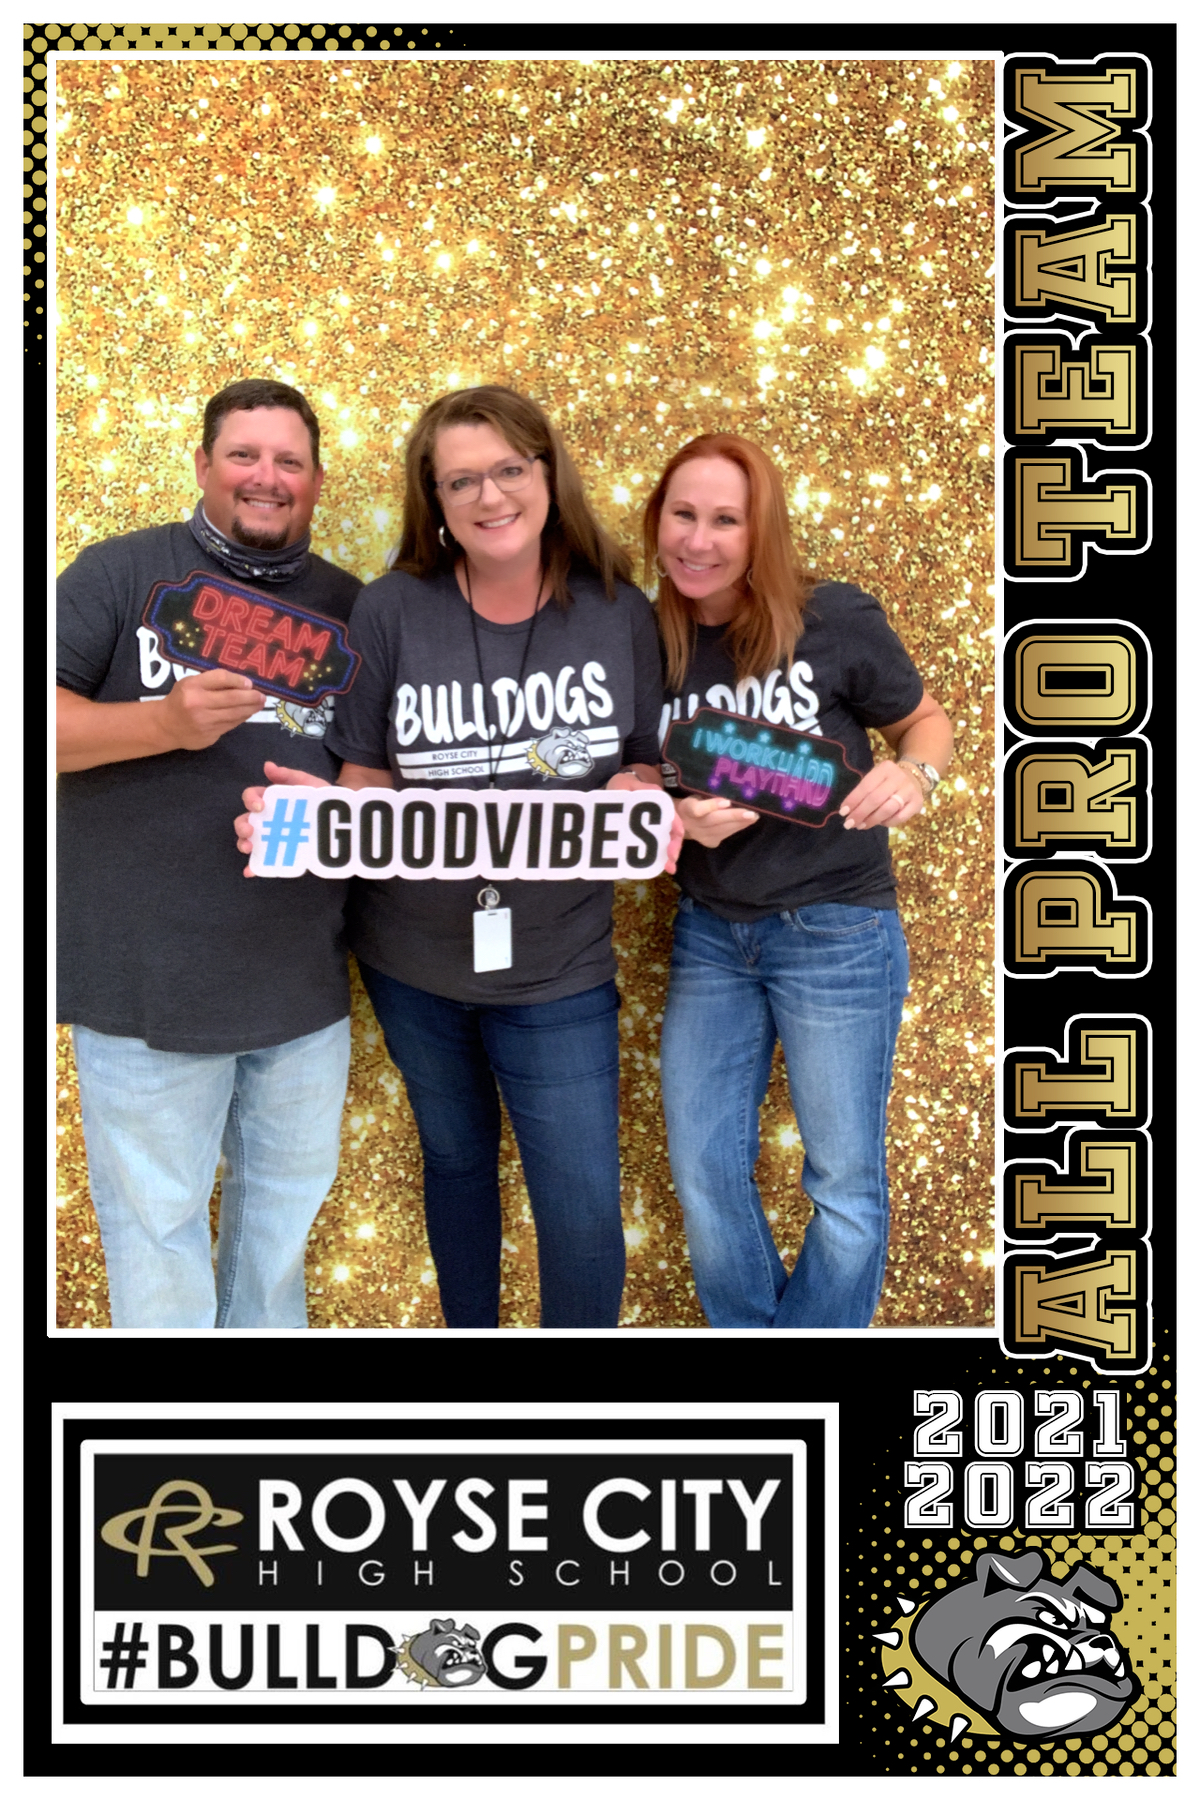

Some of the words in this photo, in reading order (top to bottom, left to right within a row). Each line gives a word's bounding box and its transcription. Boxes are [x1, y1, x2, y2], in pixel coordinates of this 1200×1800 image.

[192, 586, 331, 660] DREAM
[202, 624, 305, 687] TEAM
[395, 661, 613, 746] BULLDOGS
[428, 767, 450, 777] HIGH
[451, 765, 485, 775] SCHOOL
[432, 752, 458, 761] ROYSE
[460, 750, 478, 759] CITY
[706, 731, 781, 768] WORK
[261, 798, 662, 869] #GOODVIBES
